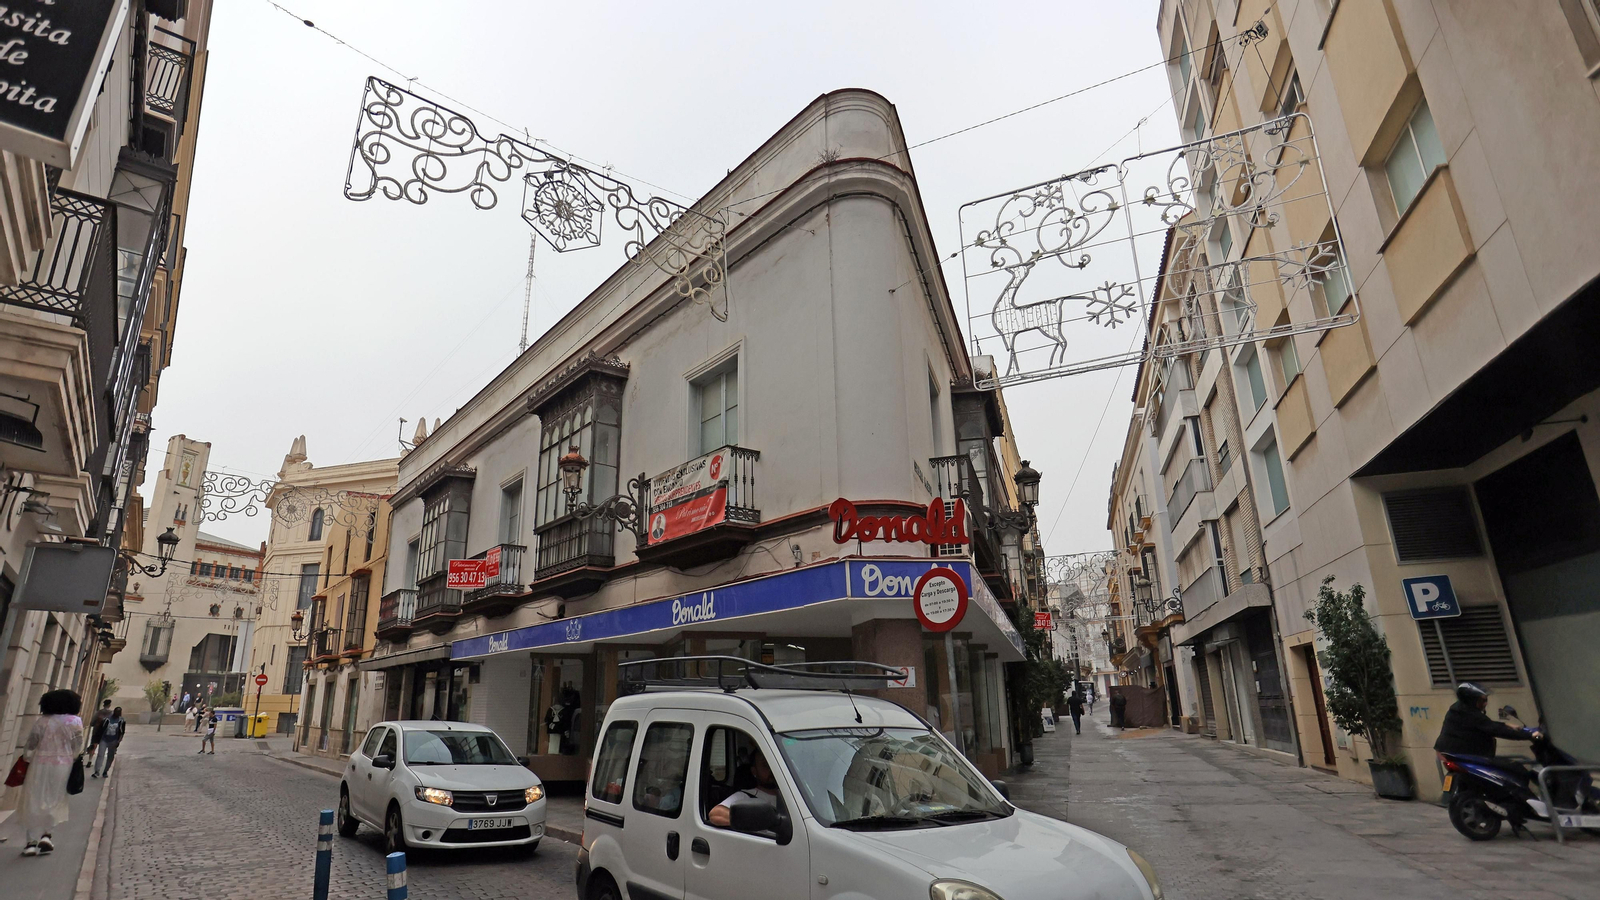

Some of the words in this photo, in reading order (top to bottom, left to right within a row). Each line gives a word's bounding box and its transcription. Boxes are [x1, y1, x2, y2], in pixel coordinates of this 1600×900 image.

[828, 497, 971, 545] Donald
[448, 572, 459, 583] 956
[460, 572, 468, 583] 30
[469, 571, 477, 583] 47
[478, 571, 486, 583] 13
[929, 580, 946, 588] Excepto
[936, 586, 956, 595] Descarga
[1410, 582, 1440, 613] P
[671, 592, 716, 625] Donald
[488, 632, 509, 654] Donald
[473, 819, 495, 829] 3769
[496, 818, 512, 828] JJW
